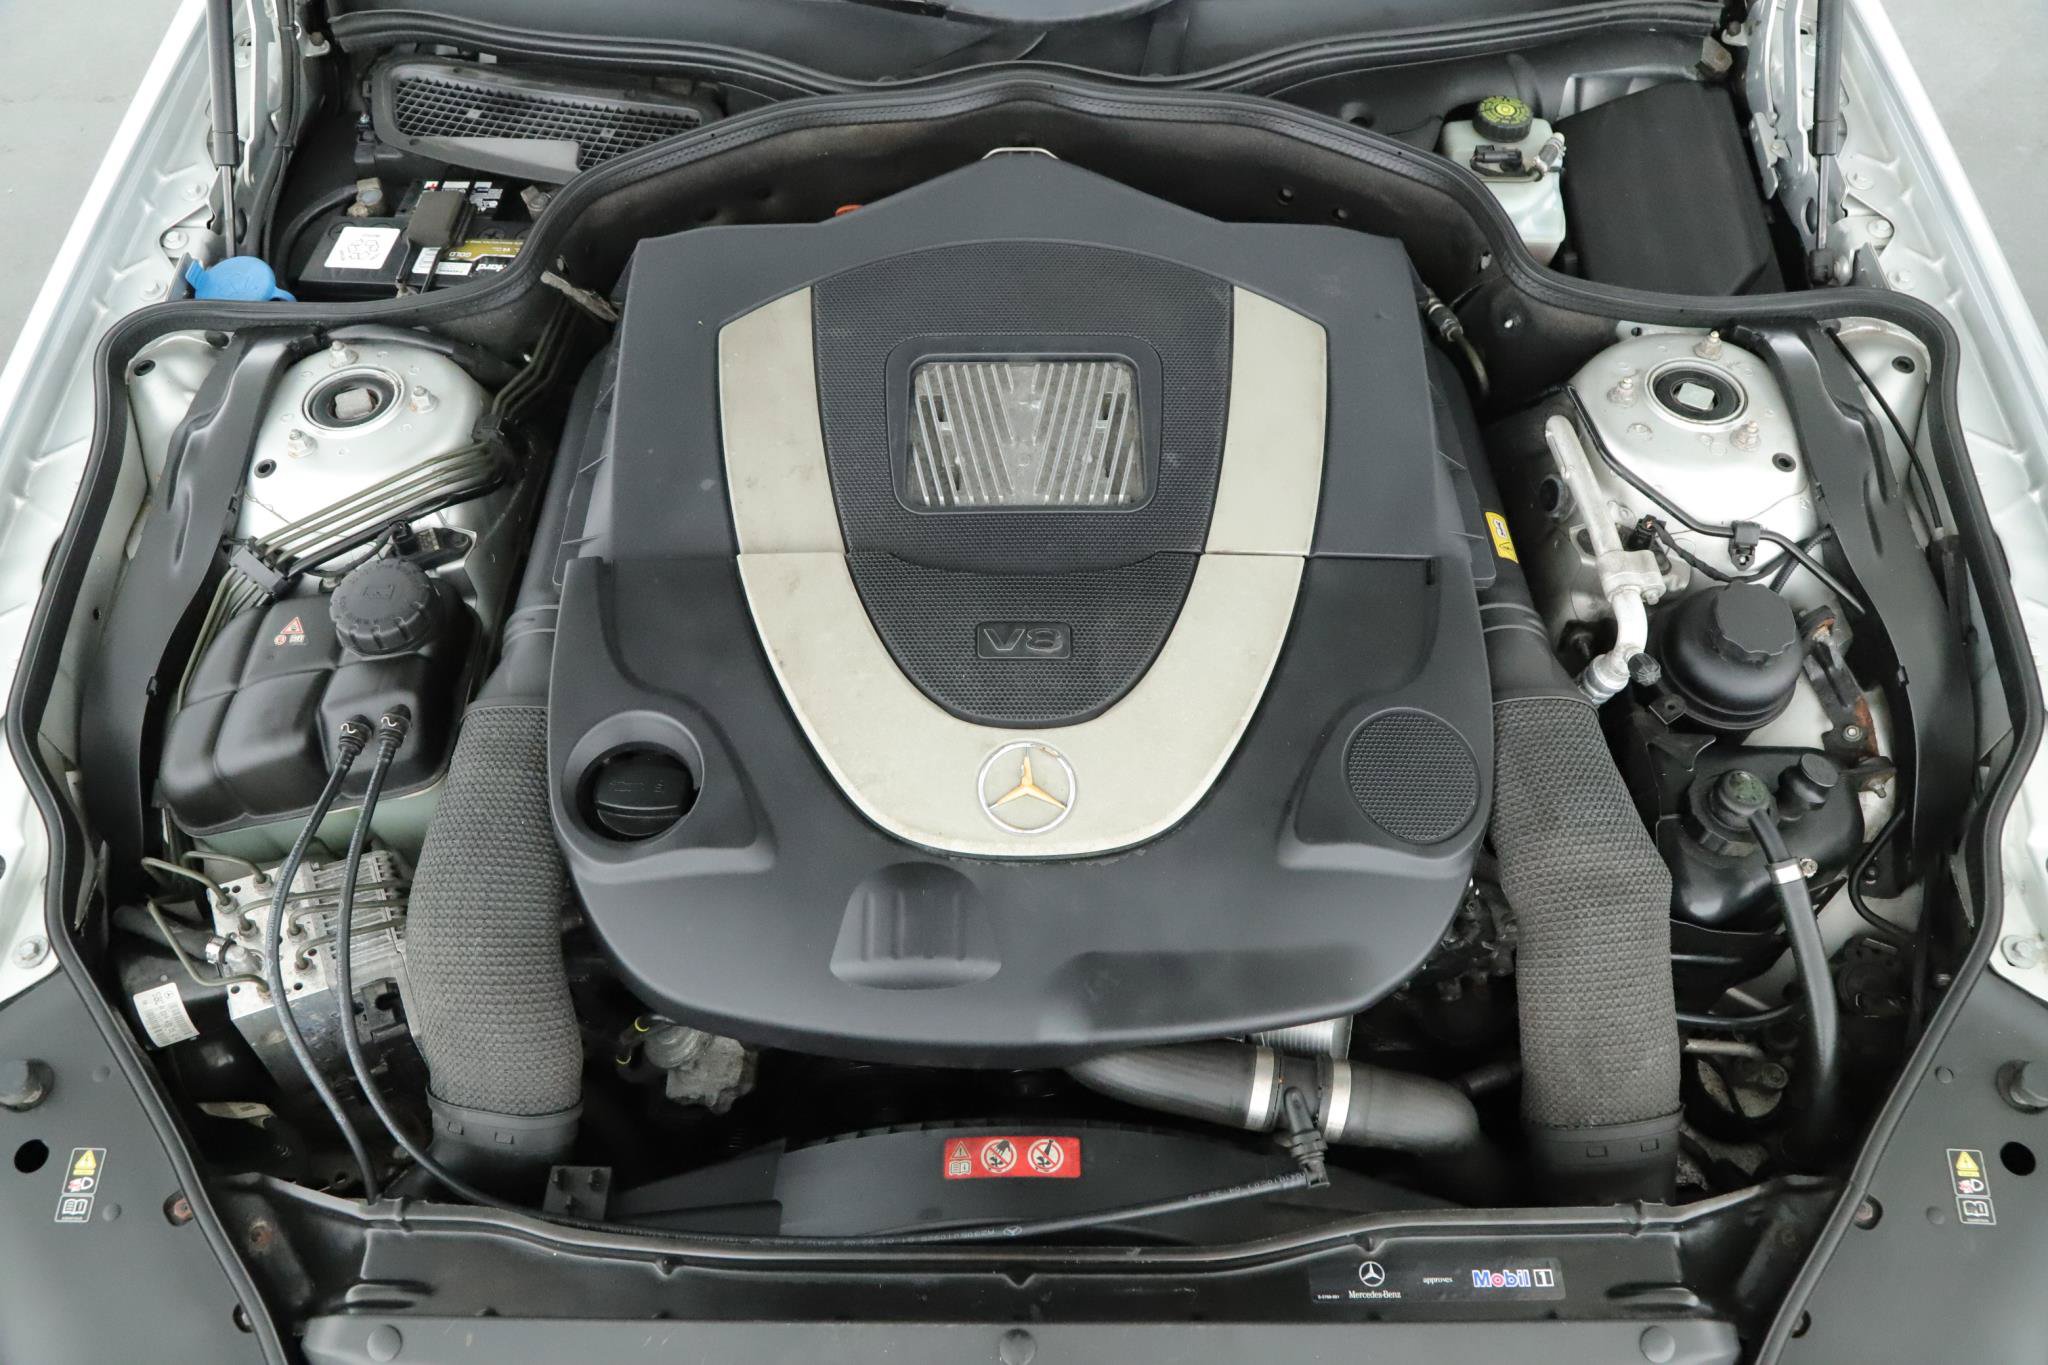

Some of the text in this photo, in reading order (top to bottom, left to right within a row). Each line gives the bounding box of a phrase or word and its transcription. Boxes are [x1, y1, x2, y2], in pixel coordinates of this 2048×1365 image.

[983, 627, 1063, 652] V8
[1422, 1276, 1453, 1285] approves
[1472, 1269, 1531, 1288] Mobil
[1348, 1289, 1402, 1299] Mercedes-Benz
